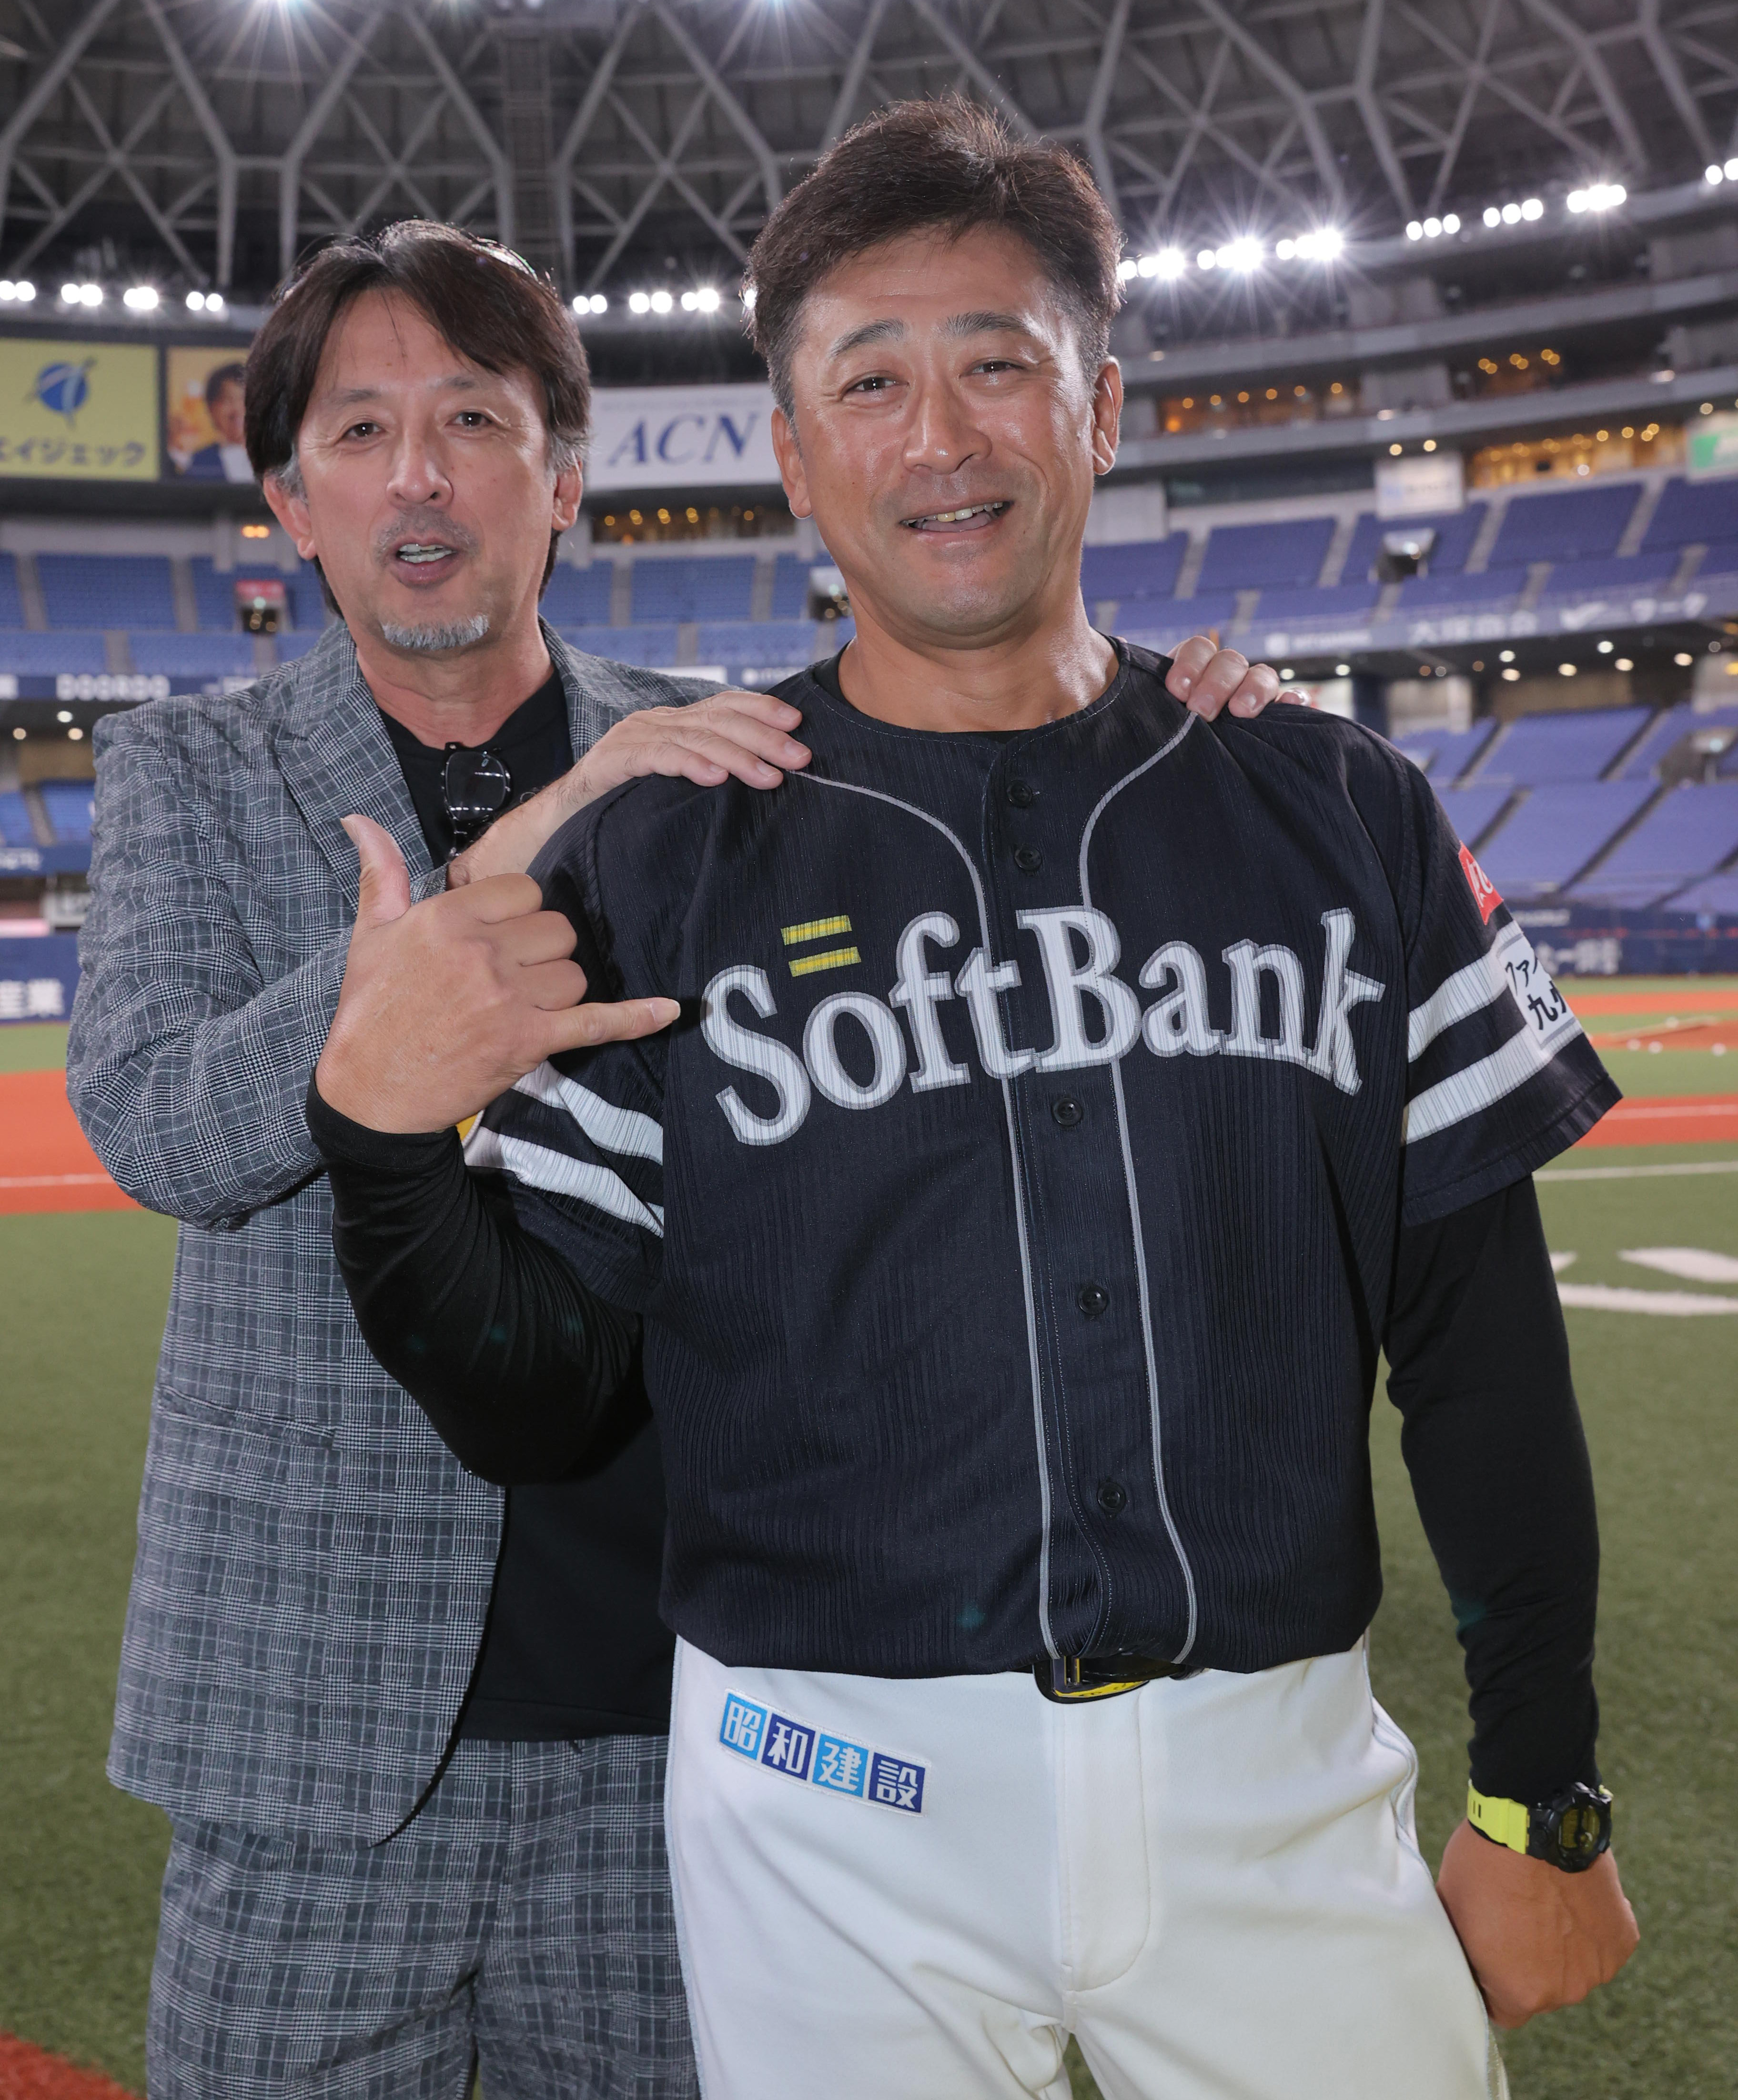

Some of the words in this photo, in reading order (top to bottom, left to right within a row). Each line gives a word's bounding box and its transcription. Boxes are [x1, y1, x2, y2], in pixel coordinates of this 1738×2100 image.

[608, 411, 758, 467] ACN
[700, 905, 1385, 1145] SoftBank
[723, 1700, 918, 1809] 昭和建設
